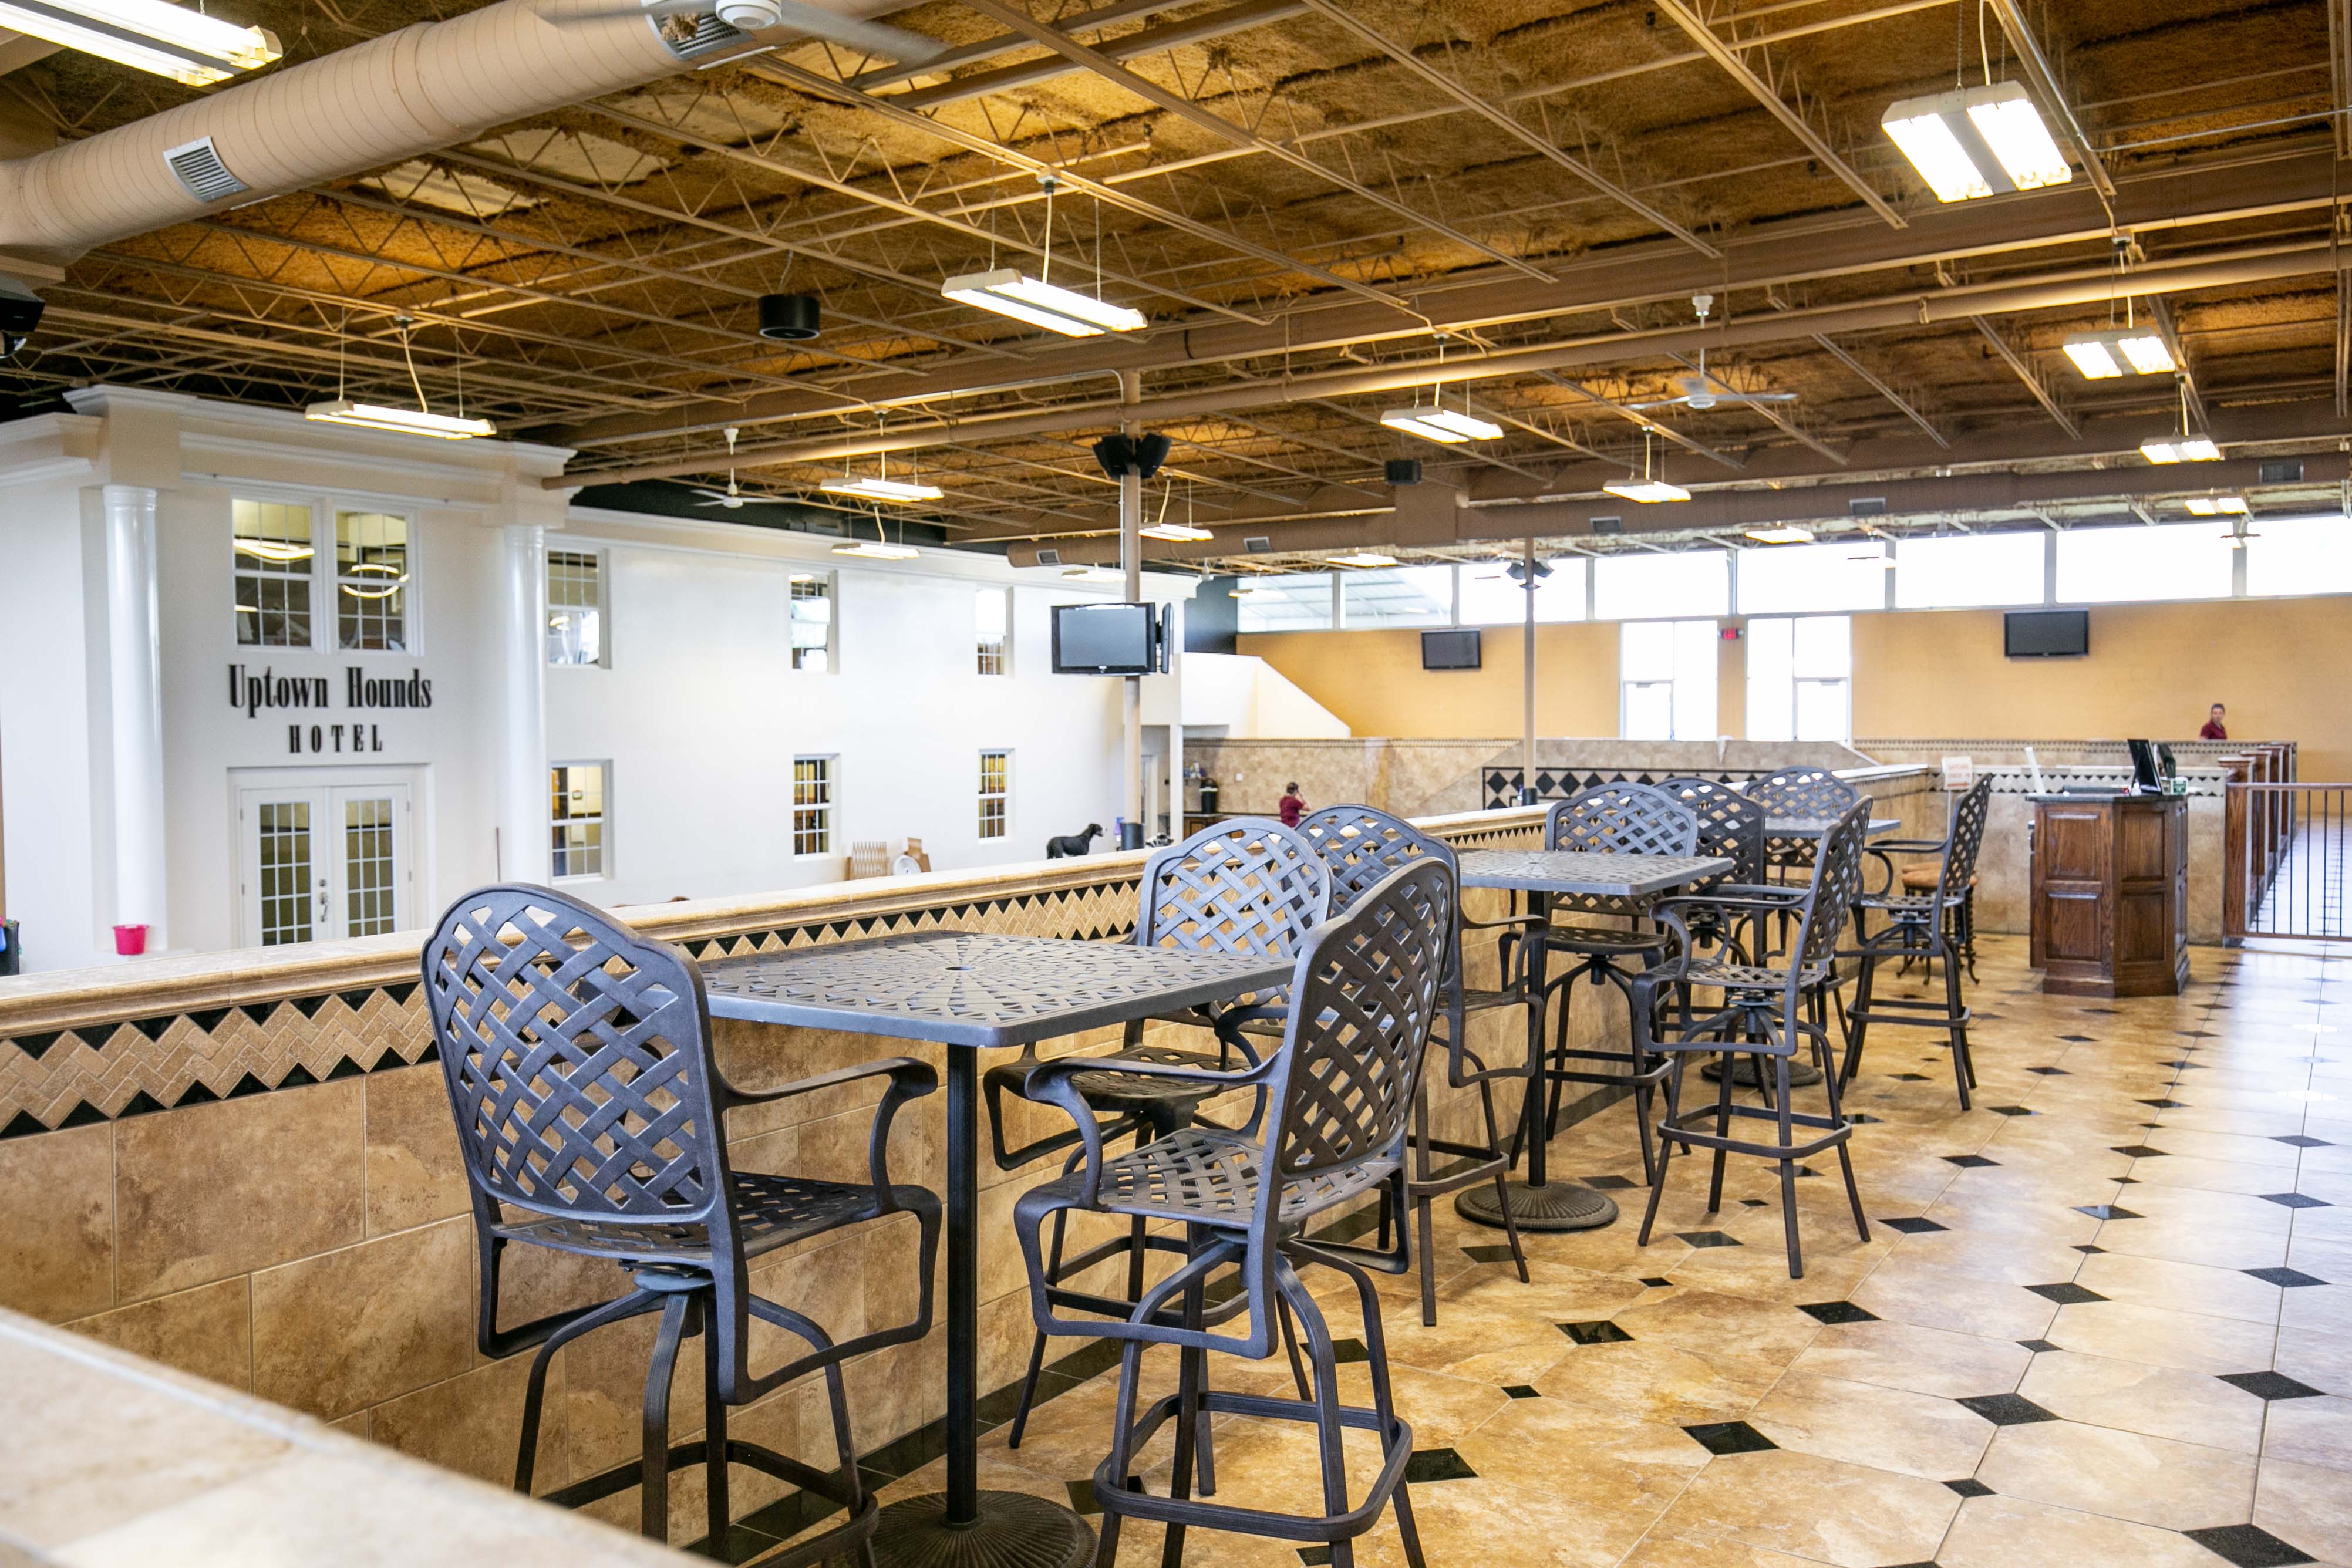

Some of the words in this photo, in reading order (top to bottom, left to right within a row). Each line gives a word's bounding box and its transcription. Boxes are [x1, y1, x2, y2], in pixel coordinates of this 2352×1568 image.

[228, 664, 329, 718] Uptown
[346, 666, 432, 707] Hounds
[289, 724, 383, 753] HOTEL
